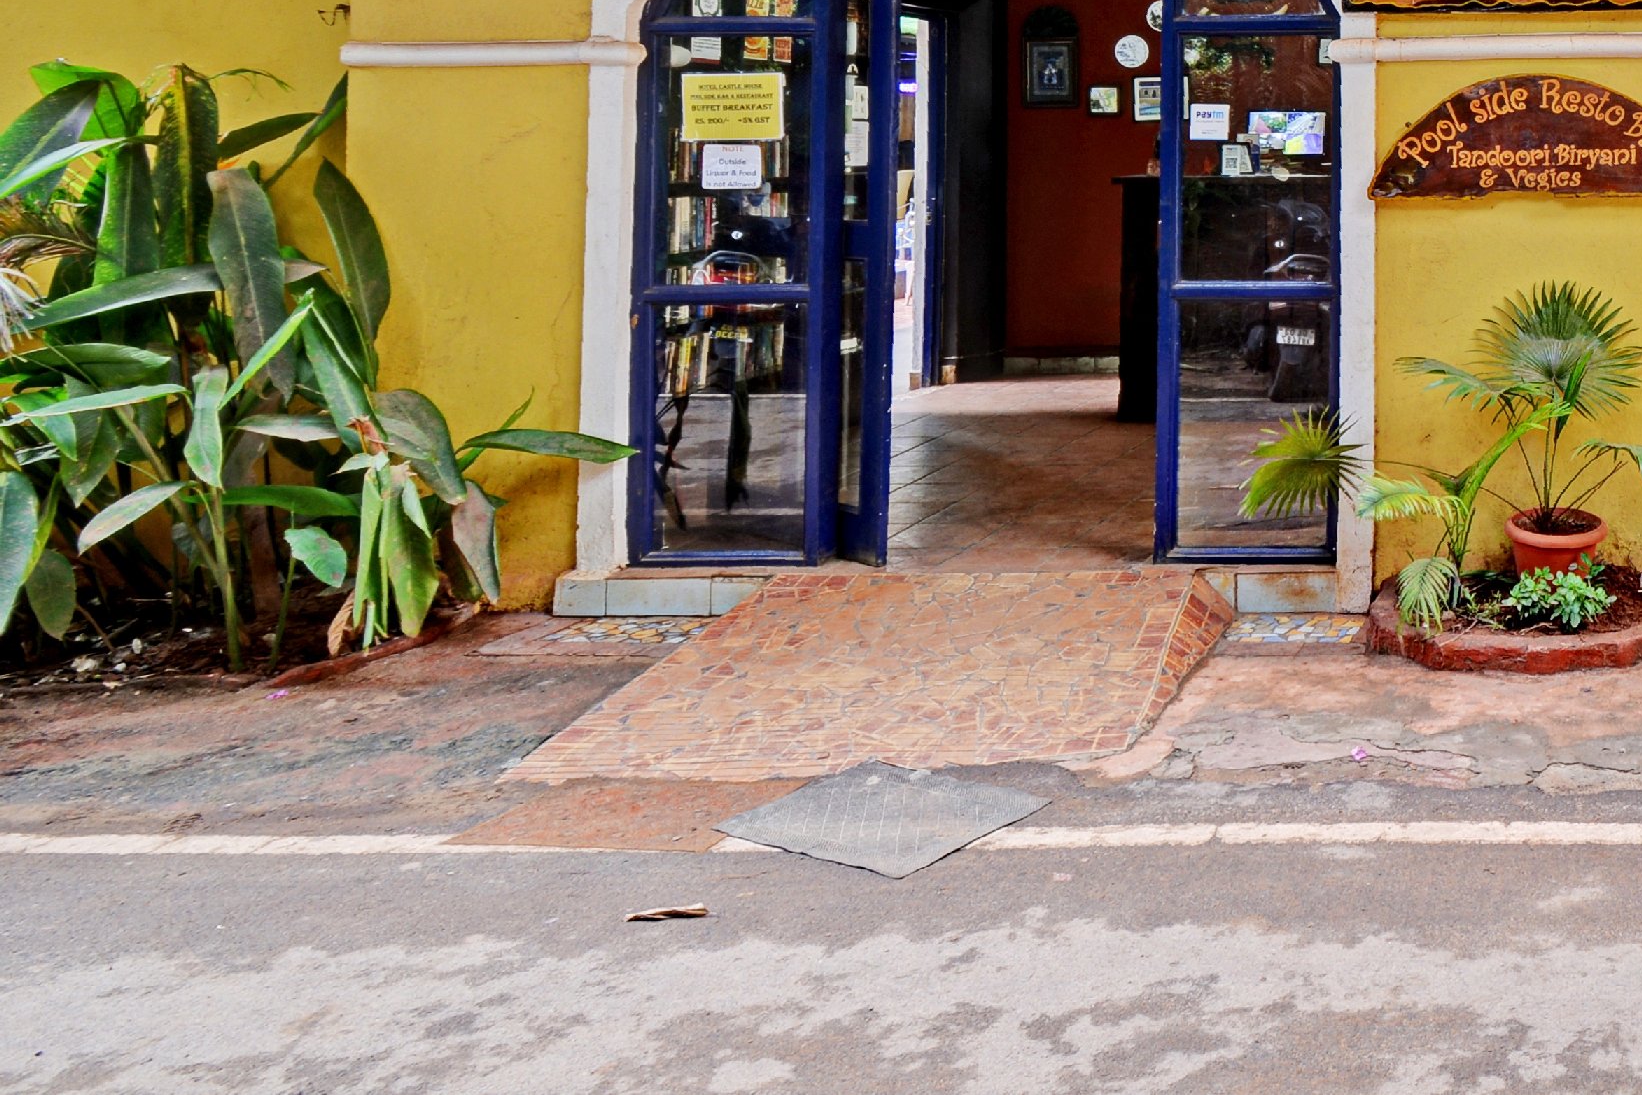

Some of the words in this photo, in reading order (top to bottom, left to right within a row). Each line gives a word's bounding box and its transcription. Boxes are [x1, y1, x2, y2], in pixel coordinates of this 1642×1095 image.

[1398, 102, 1469, 169] Pool
[1469, 80, 1529, 123] side
[1538, 78, 1625, 126] Resto
[1479, 168, 1498, 188] &
